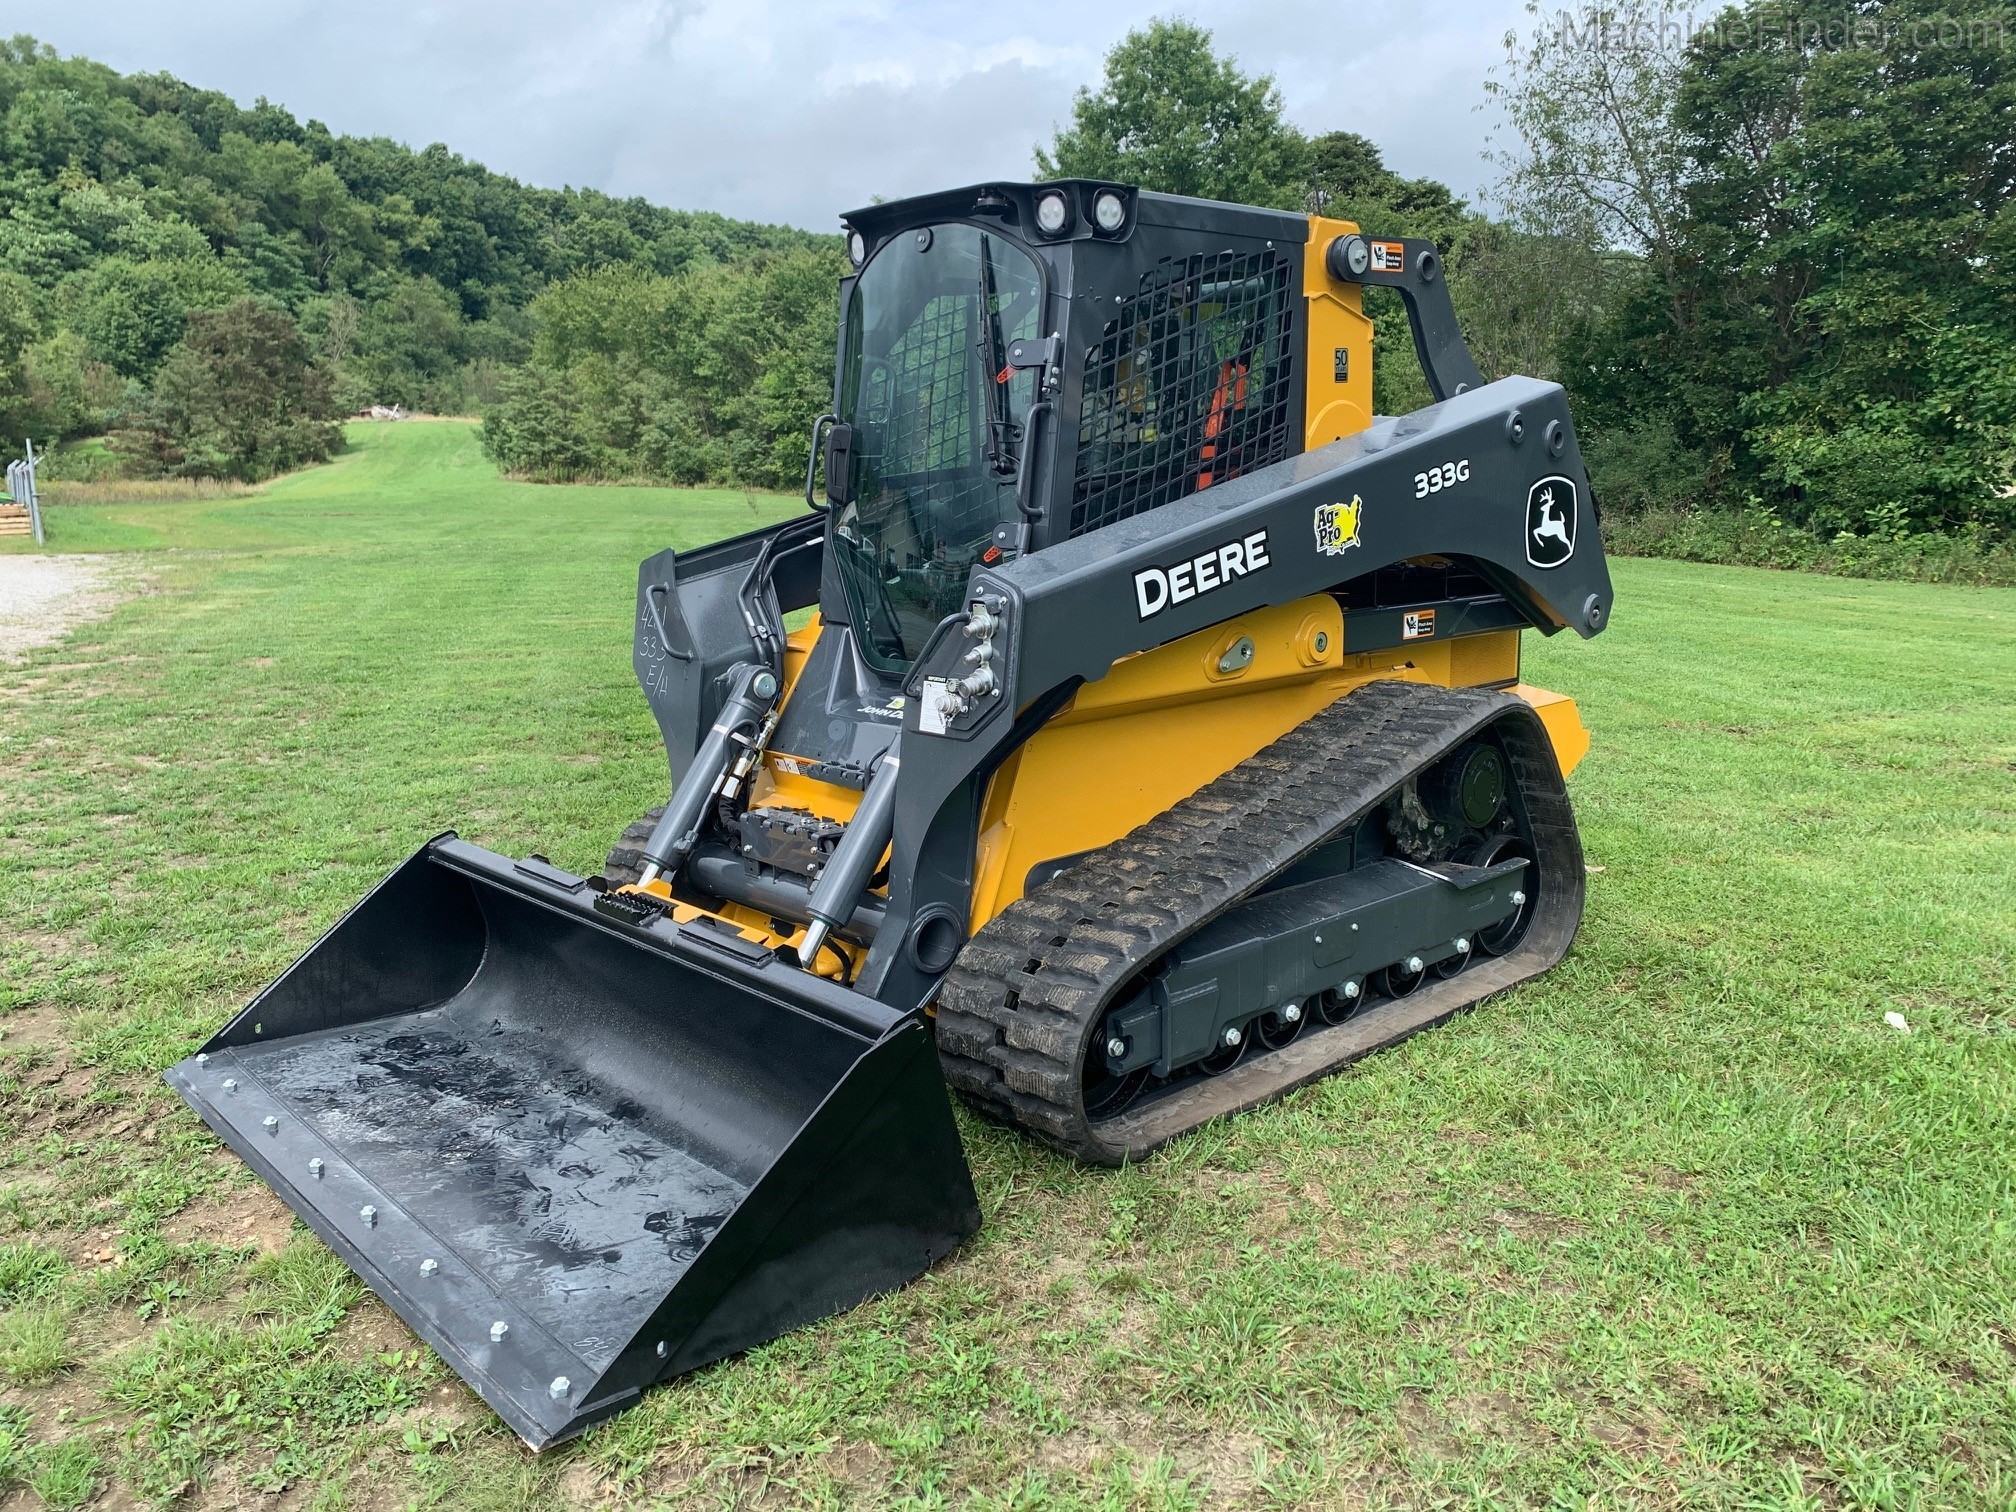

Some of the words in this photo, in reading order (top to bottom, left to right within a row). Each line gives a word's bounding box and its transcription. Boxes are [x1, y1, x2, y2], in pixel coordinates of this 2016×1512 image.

[1335, 350, 1347, 366] 50
[1414, 459, 1470, 499] 333G
[1317, 508, 1339, 529] Ag-
[1319, 527, 1341, 548] Pro
[1135, 530, 1270, 618] DEERE
[857, 705, 892, 716] JOHN
